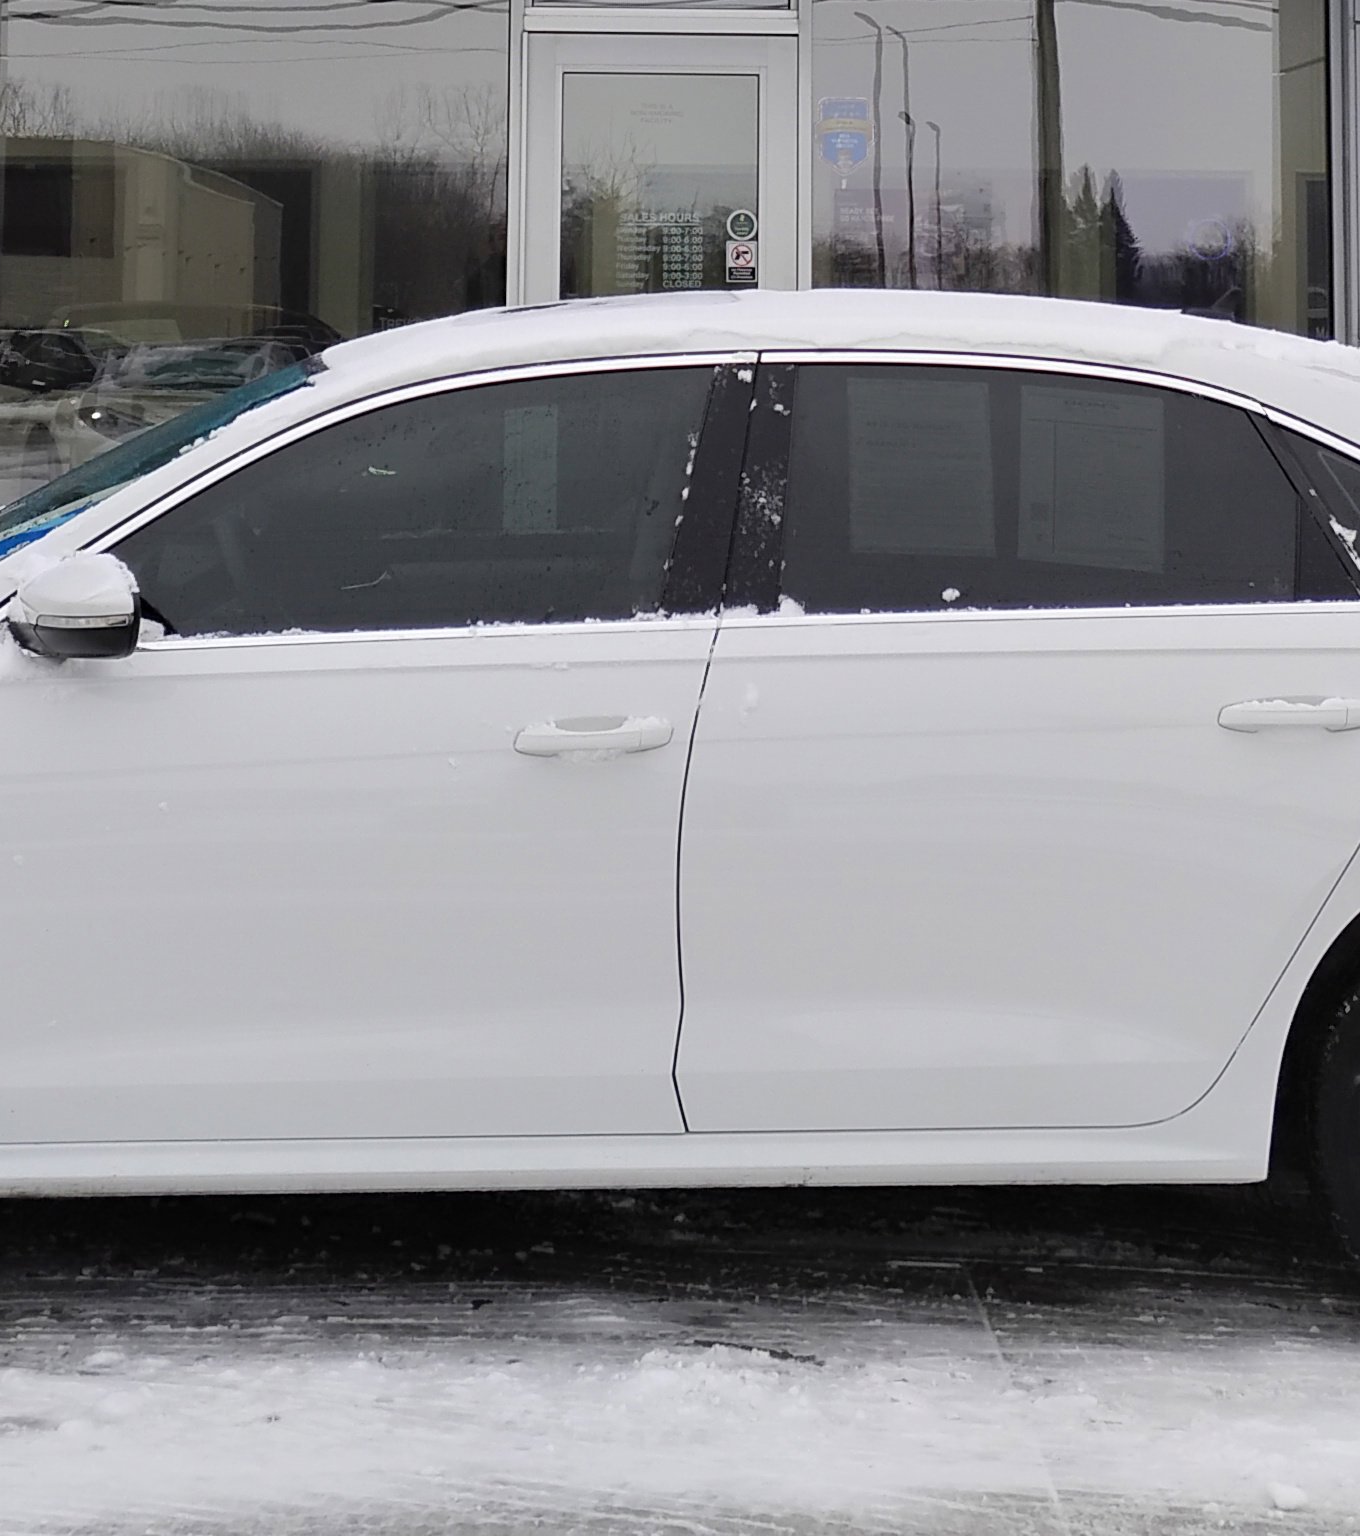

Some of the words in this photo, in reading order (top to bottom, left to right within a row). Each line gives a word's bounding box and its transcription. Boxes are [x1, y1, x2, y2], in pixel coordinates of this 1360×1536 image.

[620, 213, 656, 223] SALES
[659, 213, 700, 223] HOURS
[662, 280, 702, 288] CLOSED
